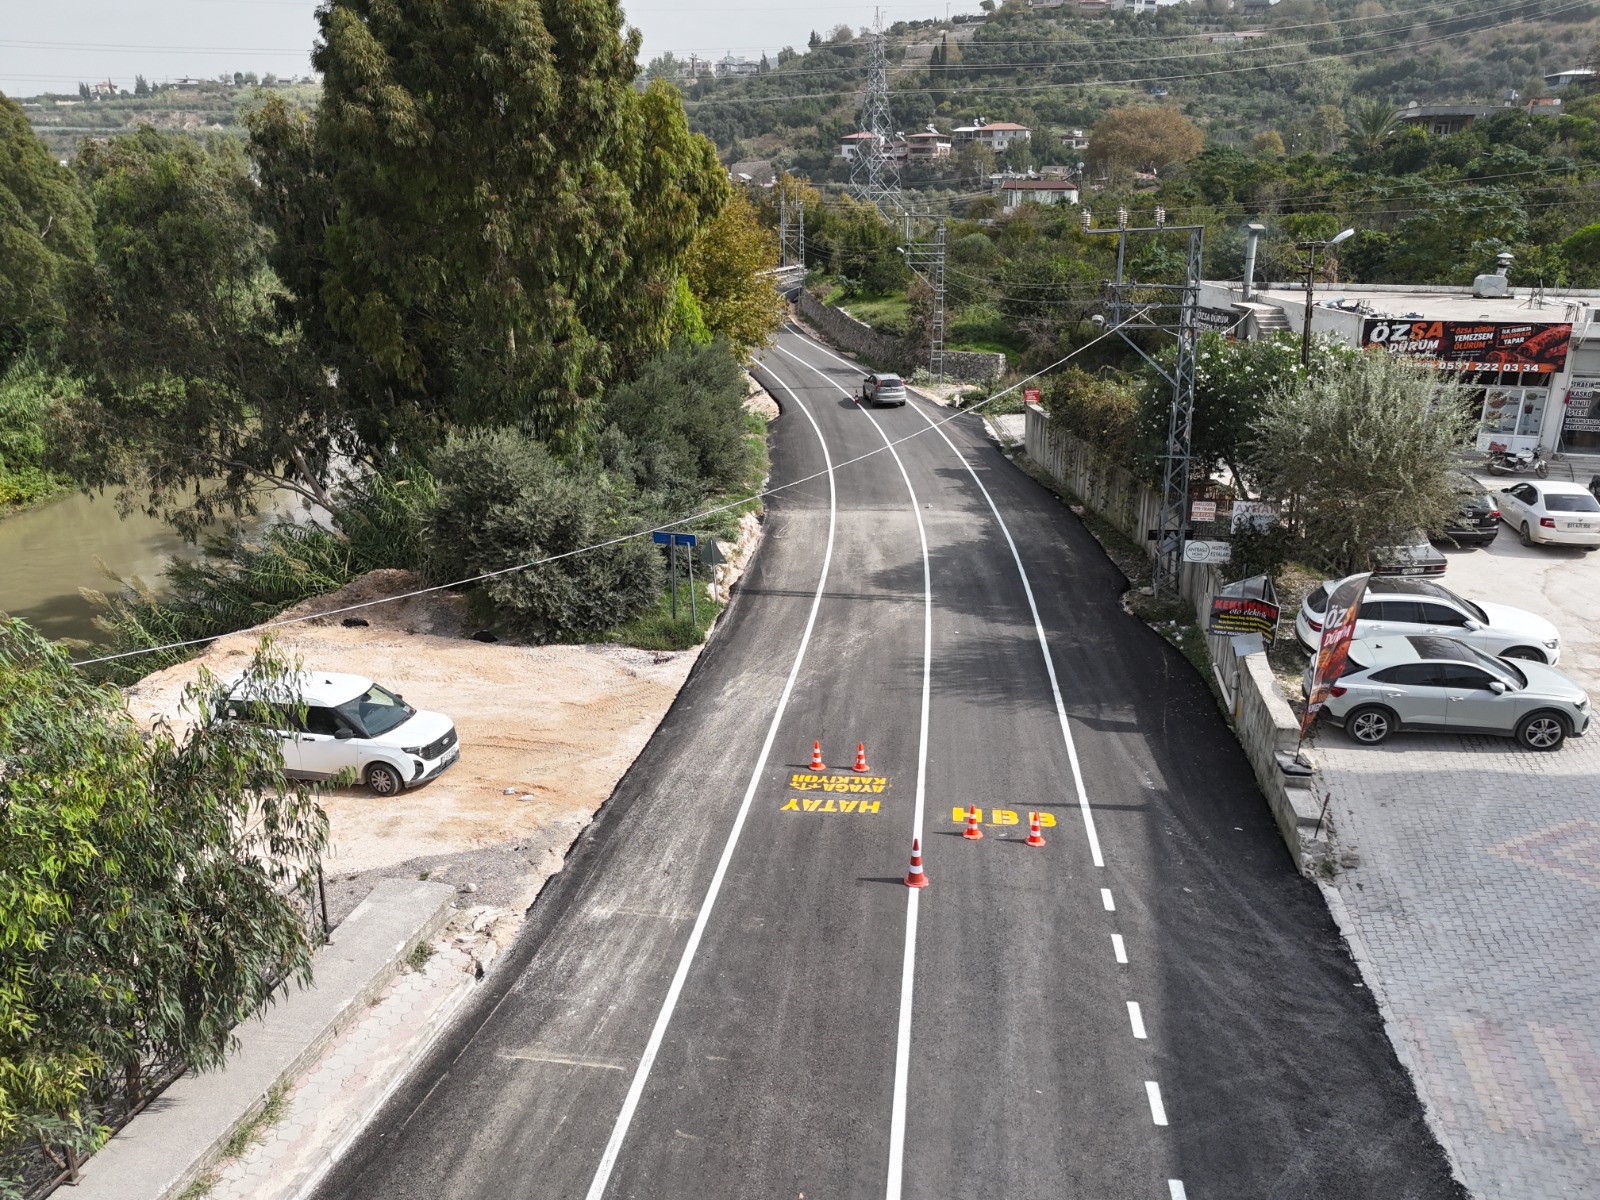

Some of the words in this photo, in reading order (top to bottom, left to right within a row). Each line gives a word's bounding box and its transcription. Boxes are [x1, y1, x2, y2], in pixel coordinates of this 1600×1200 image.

[1370, 321, 1444, 342] ÖZSA
[1473, 325, 1495, 333] DÜRÜM
[1454, 332, 1494, 342] YEMEZSEM
[1503, 337, 1525, 345] YAPAR
[1389, 340, 1439, 353] DÜRÜM
[1474, 362, 1499, 371] 222
[1503, 363, 1519, 371] 03
[1522, 364, 1539, 372] 34
[1571, 390, 1593, 398] KASKO
[792, 774, 887, 785] KALKIYOR
[780, 798, 881, 814] HATAY
